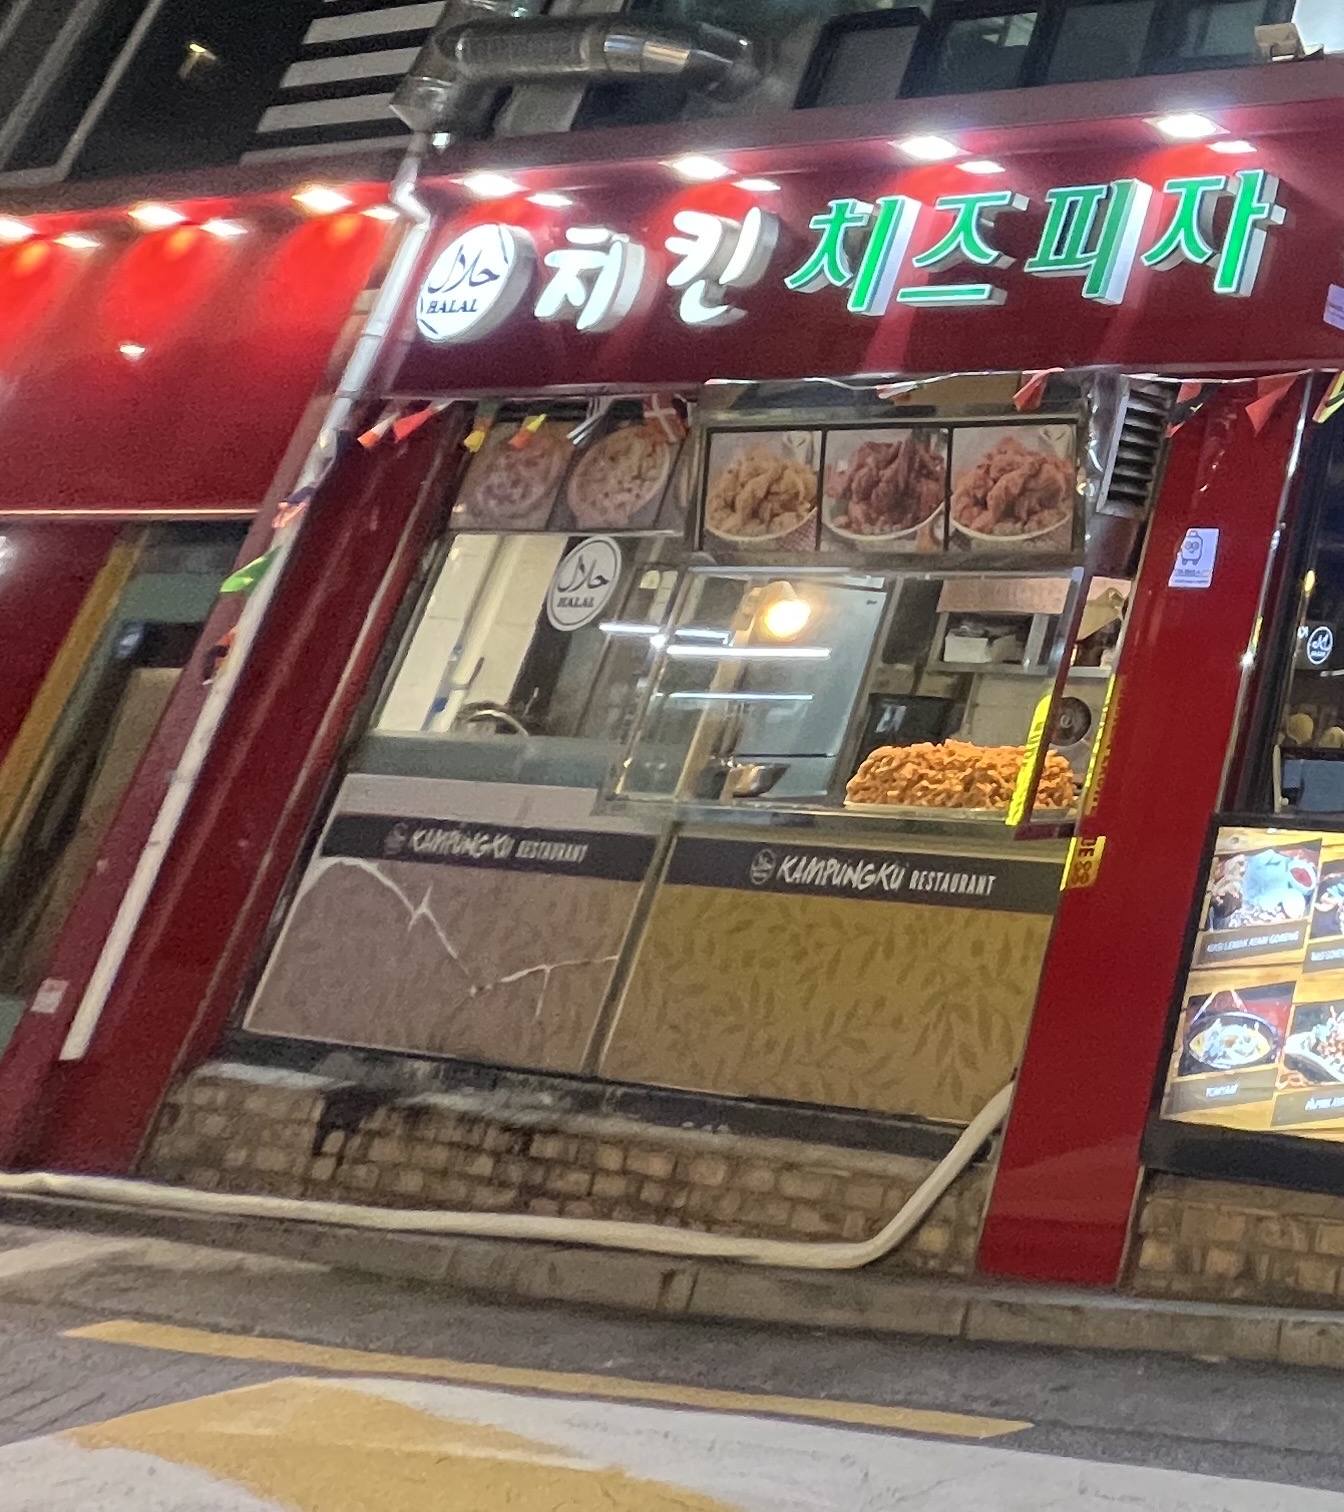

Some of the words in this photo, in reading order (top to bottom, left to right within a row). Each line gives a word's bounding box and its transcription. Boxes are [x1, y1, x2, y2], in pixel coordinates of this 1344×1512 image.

[785, 167, 1278, 317] 치즈피자
[426, 299, 478, 314] HALAL
[409, 828, 515, 859] KAMPUNGKU
[515, 840, 588, 863] RESTAURANT
[776, 854, 906, 891] KAMPUNGKU
[909, 870, 996, 896] RESTAURANT
